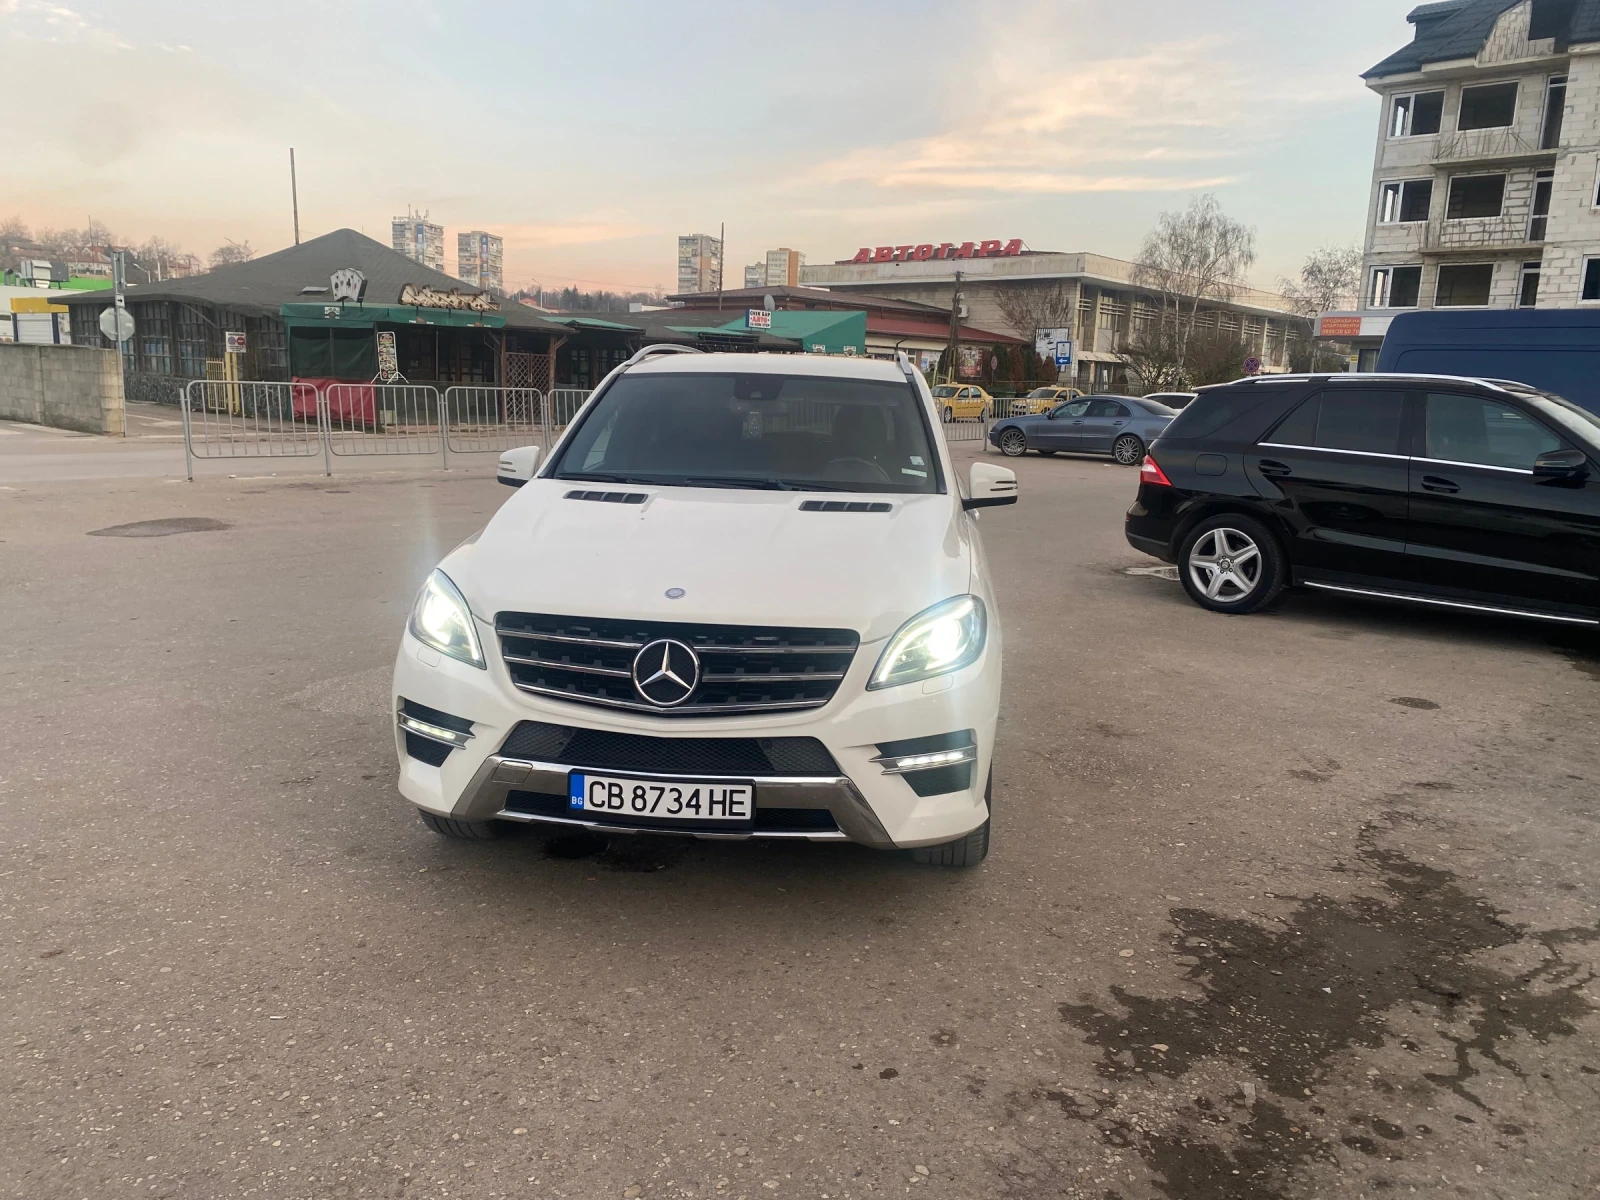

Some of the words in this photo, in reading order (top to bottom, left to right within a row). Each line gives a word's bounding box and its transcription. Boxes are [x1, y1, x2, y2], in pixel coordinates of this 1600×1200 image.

[851, 238, 1023, 264] АВТОГАРА
[571, 796, 583, 805] BG
[589, 781, 624, 810] CB
[631, 785, 701, 815] 8734
[708, 788, 746, 817] HE
